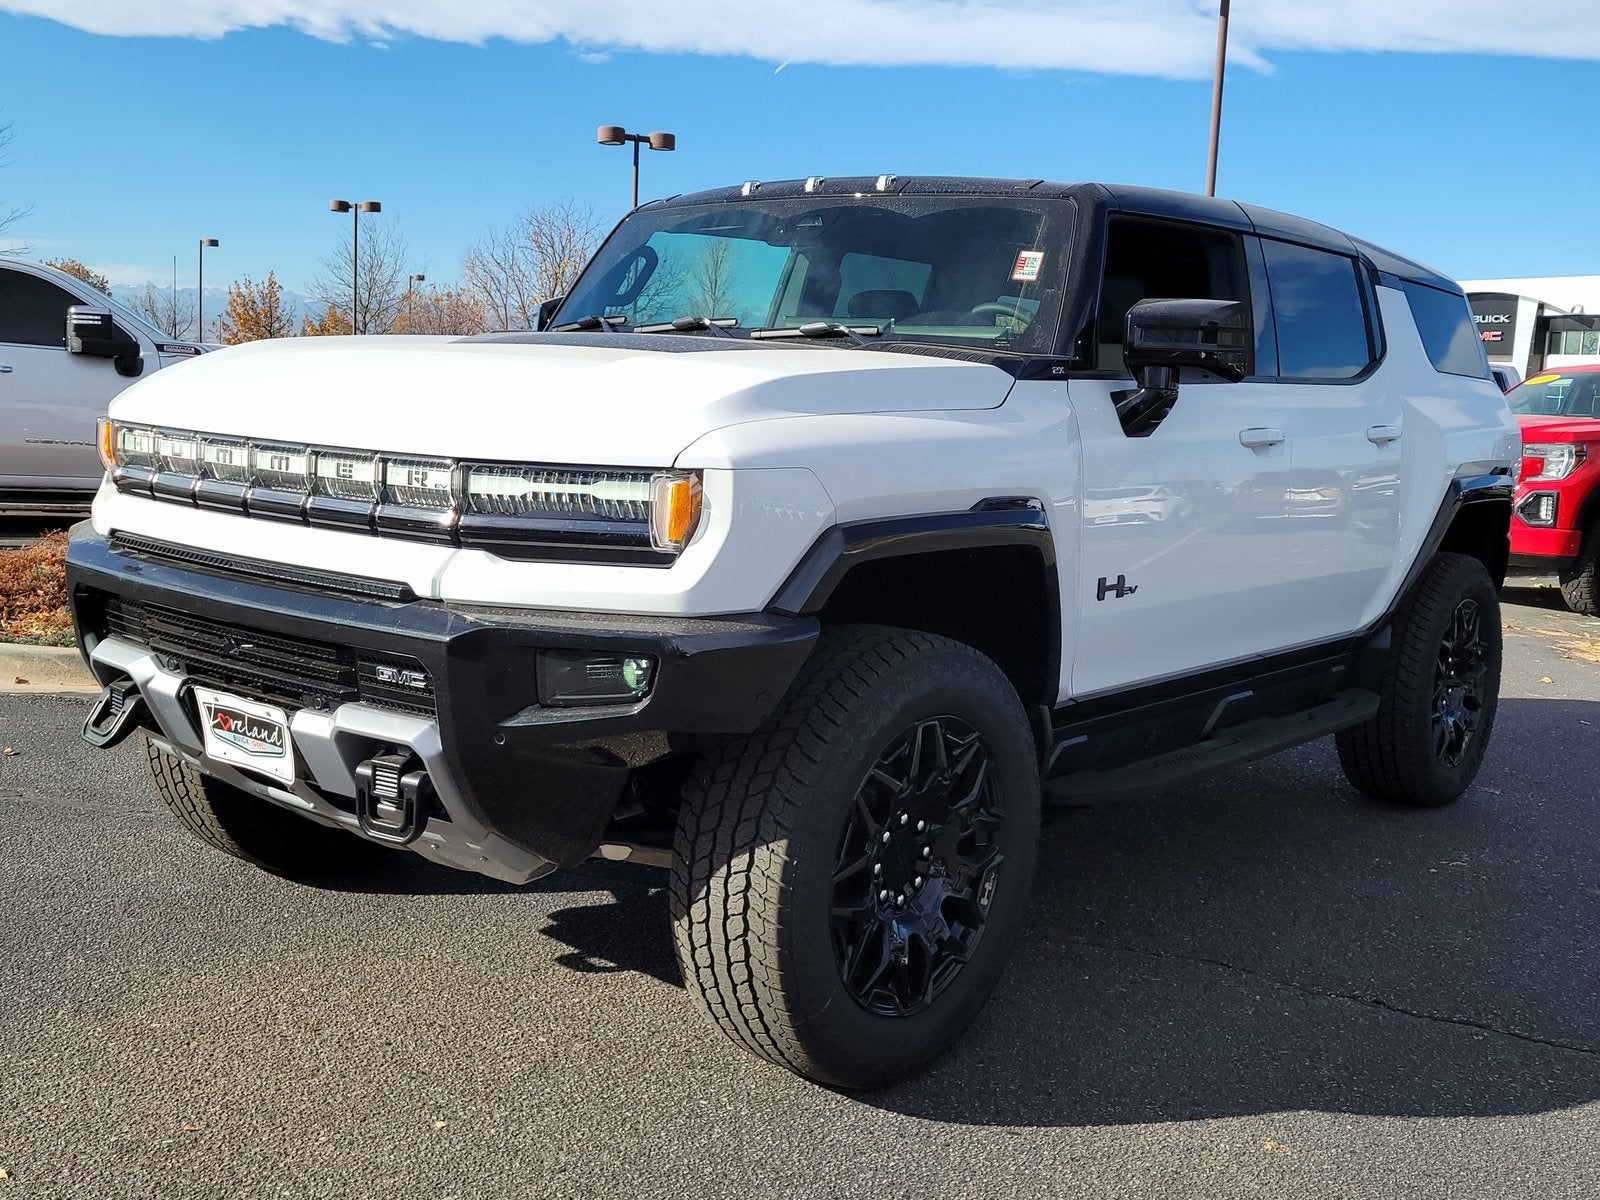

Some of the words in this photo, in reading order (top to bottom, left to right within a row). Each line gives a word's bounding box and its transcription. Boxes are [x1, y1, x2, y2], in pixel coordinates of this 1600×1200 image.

[1473, 314, 1510, 323] BUICK
[1479, 331, 1502, 341] MC
[376, 666, 427, 689] GMC
